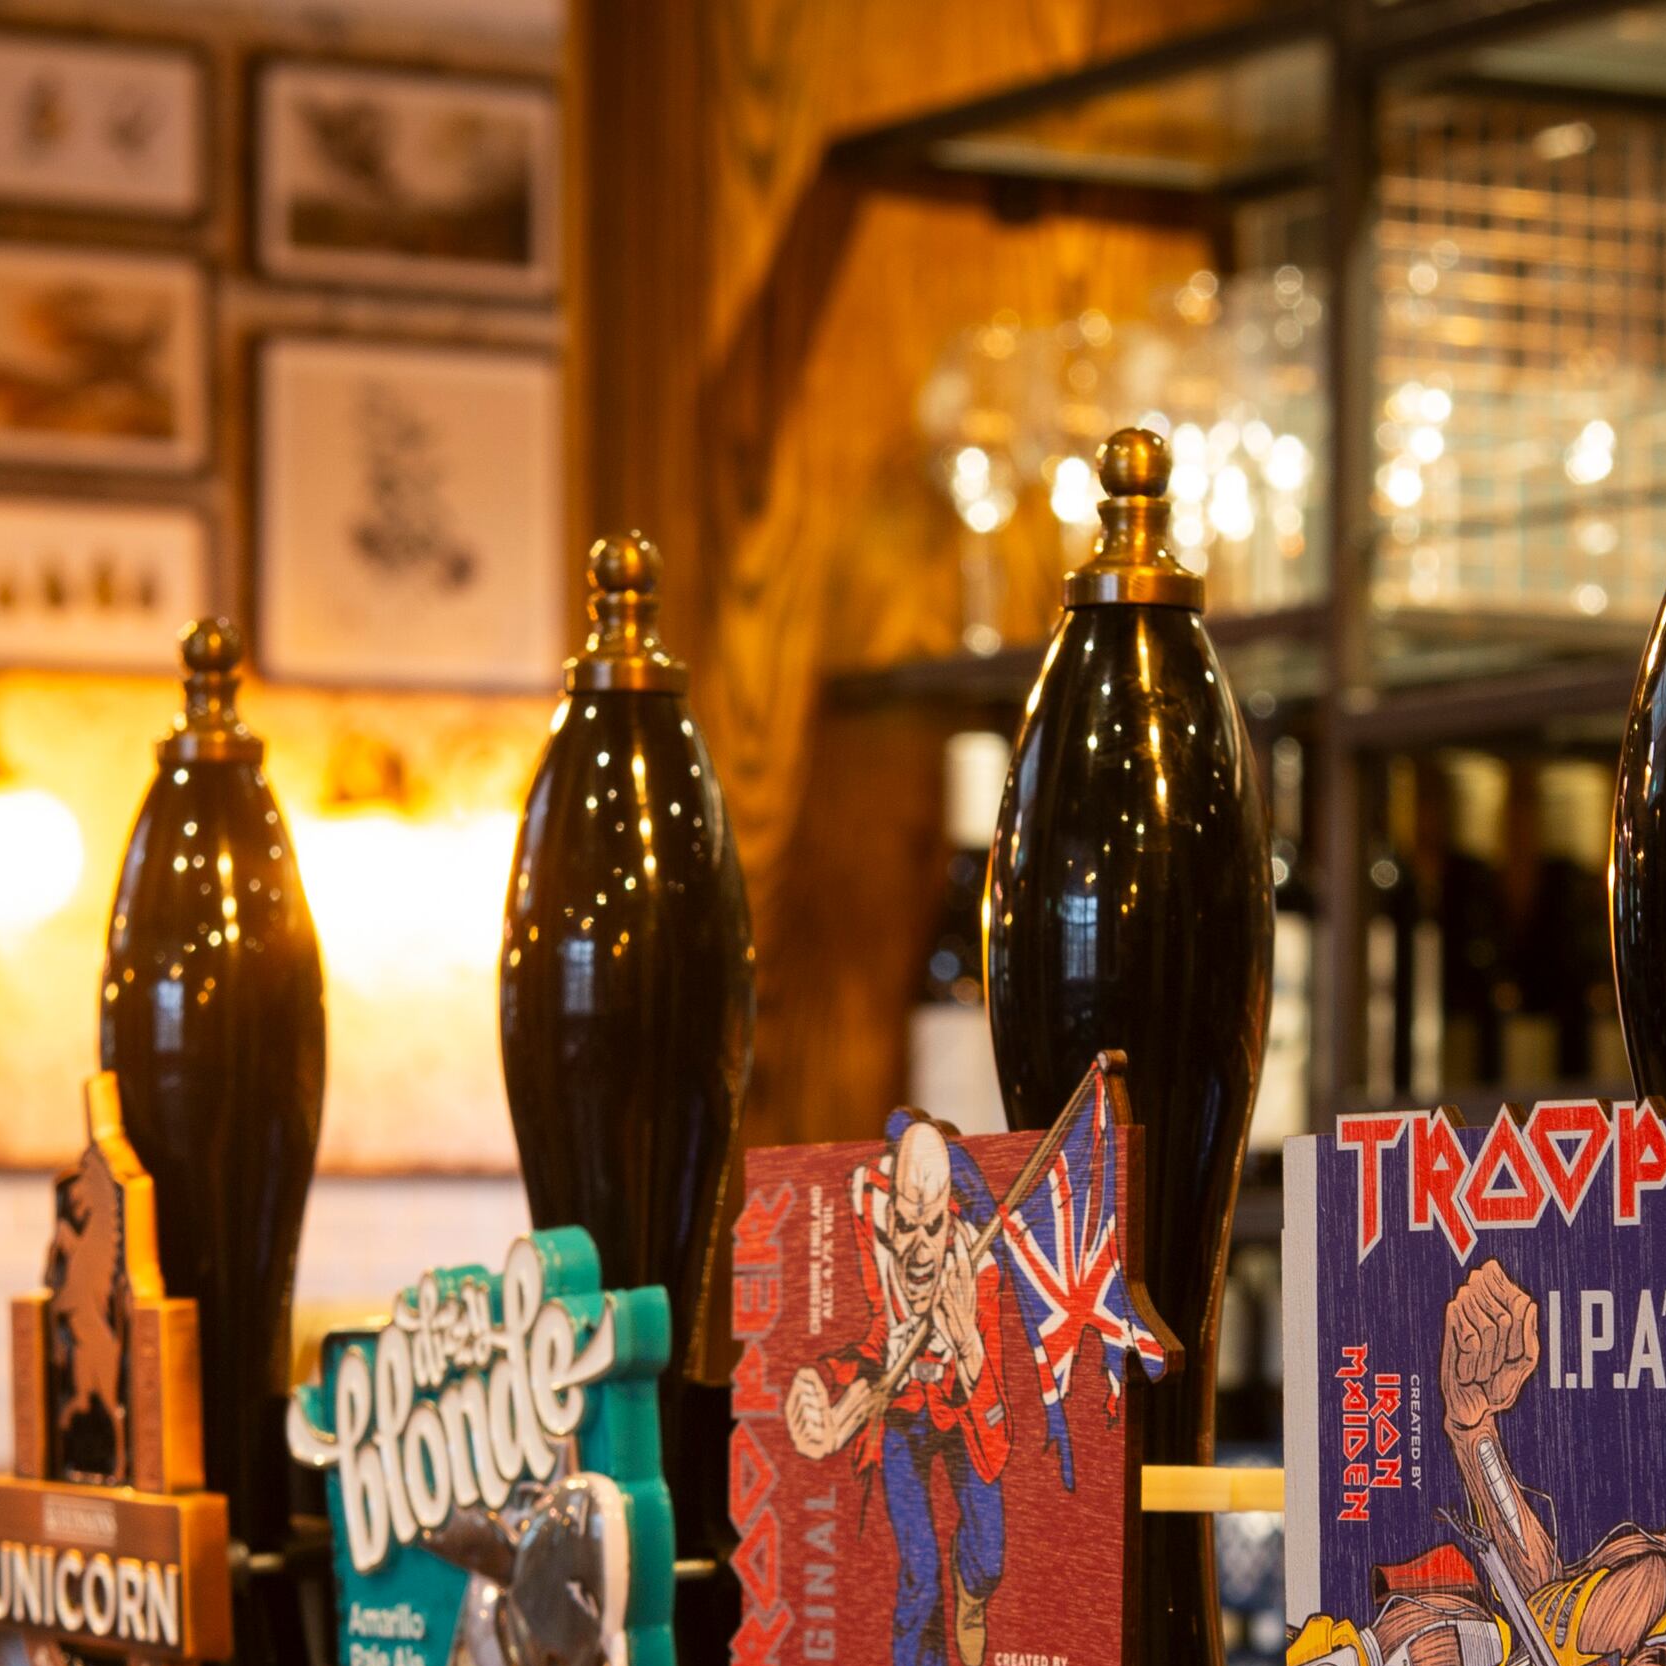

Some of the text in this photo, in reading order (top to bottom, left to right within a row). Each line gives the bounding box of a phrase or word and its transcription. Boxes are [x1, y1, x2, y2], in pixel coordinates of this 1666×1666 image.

[286, 1236, 616, 1575] blonde
[1335, 1342, 1370, 1521] MAIDEN
[1369, 1373, 1402, 1488] IRON
[1409, 1373, 1422, 1491] CREATED BY
[348, 1601, 426, 1640] Amarillo
